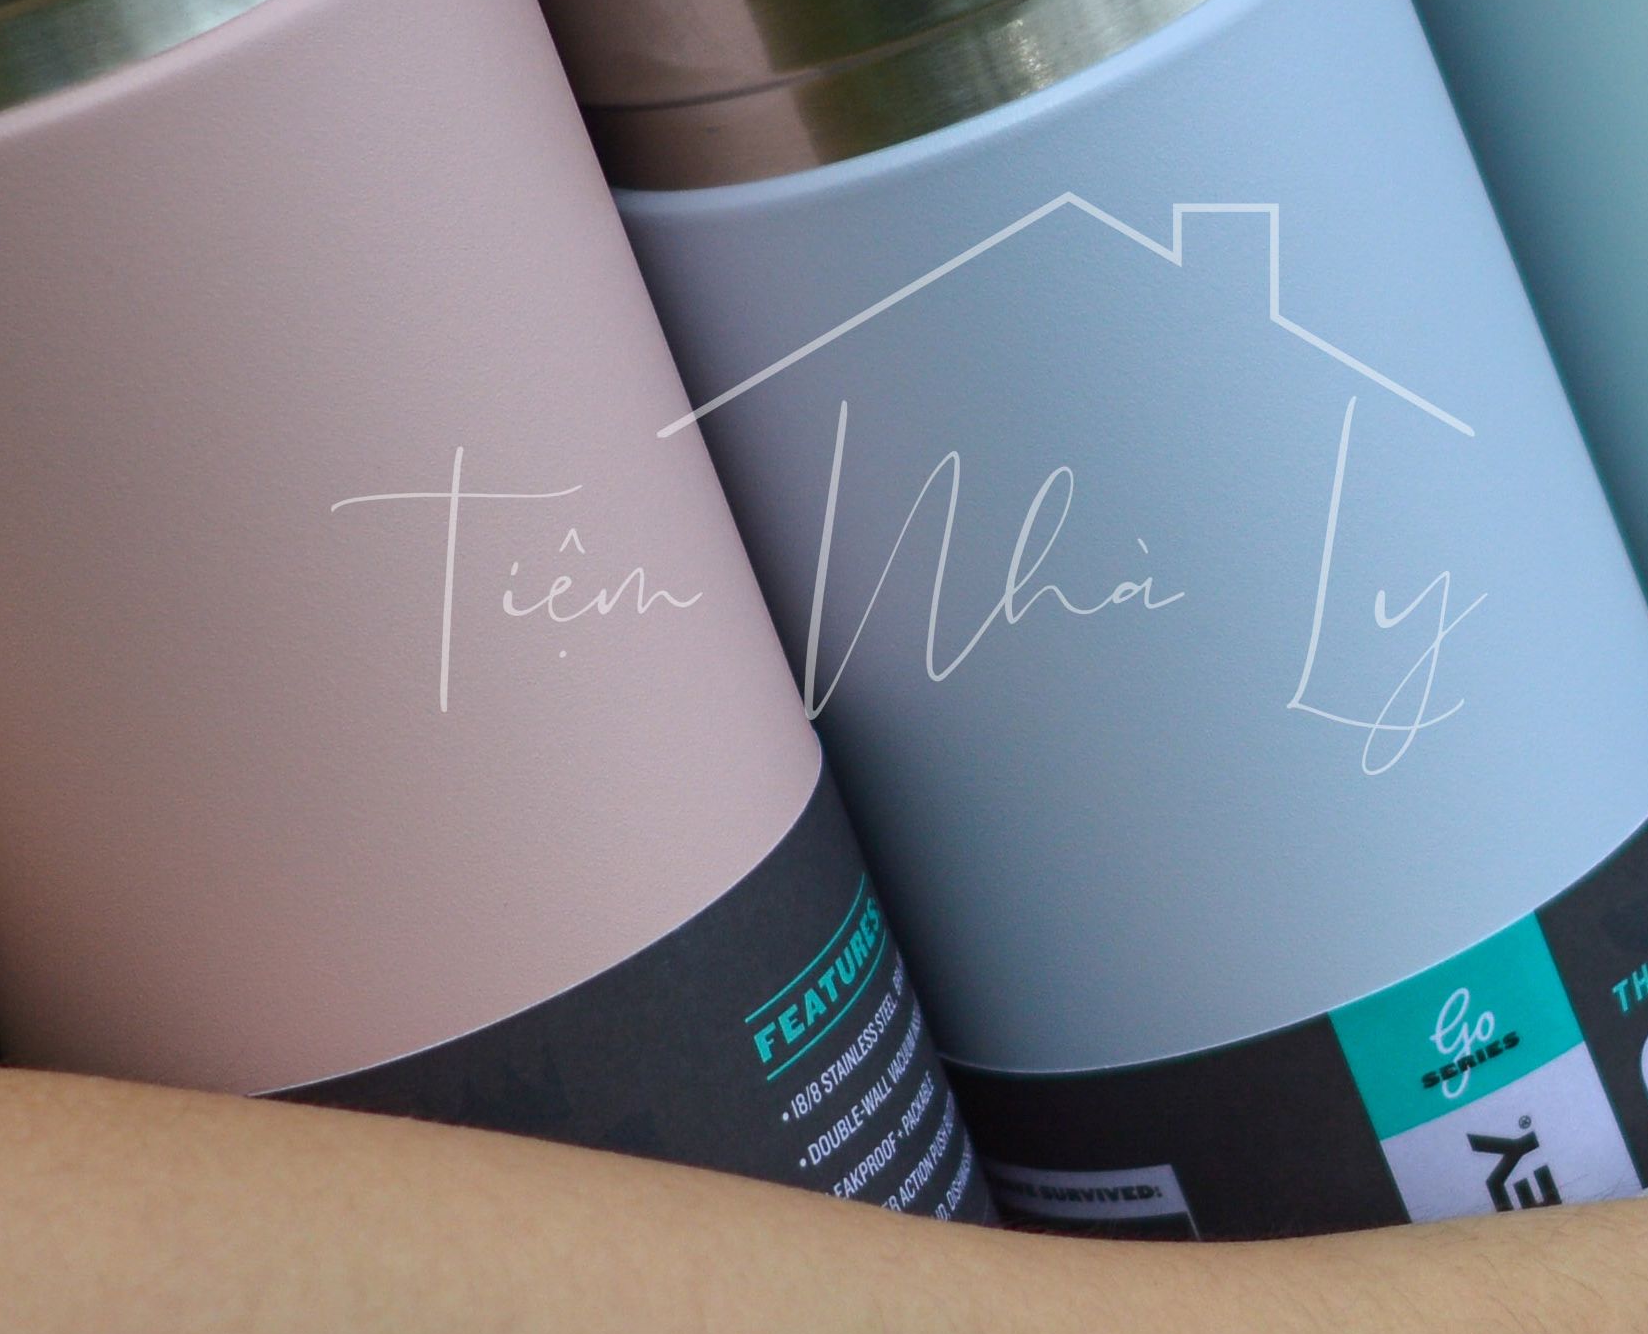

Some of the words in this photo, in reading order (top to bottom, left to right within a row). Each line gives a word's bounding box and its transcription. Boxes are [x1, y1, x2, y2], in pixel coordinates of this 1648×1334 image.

[753, 897, 880, 1063] FEATURES
[791, 1081, 822, 1119] 18/8
[821, 1022, 878, 1093] STAINLESS
[1421, 1031, 1520, 1089] SERIES
[1429, 987, 1495, 1099] Go
[807, 1075, 892, 1165] DOUBLE-WALL
[825, 1131, 898, 1199] EAKPROOF
[899, 1154, 934, 1207] ACTION
